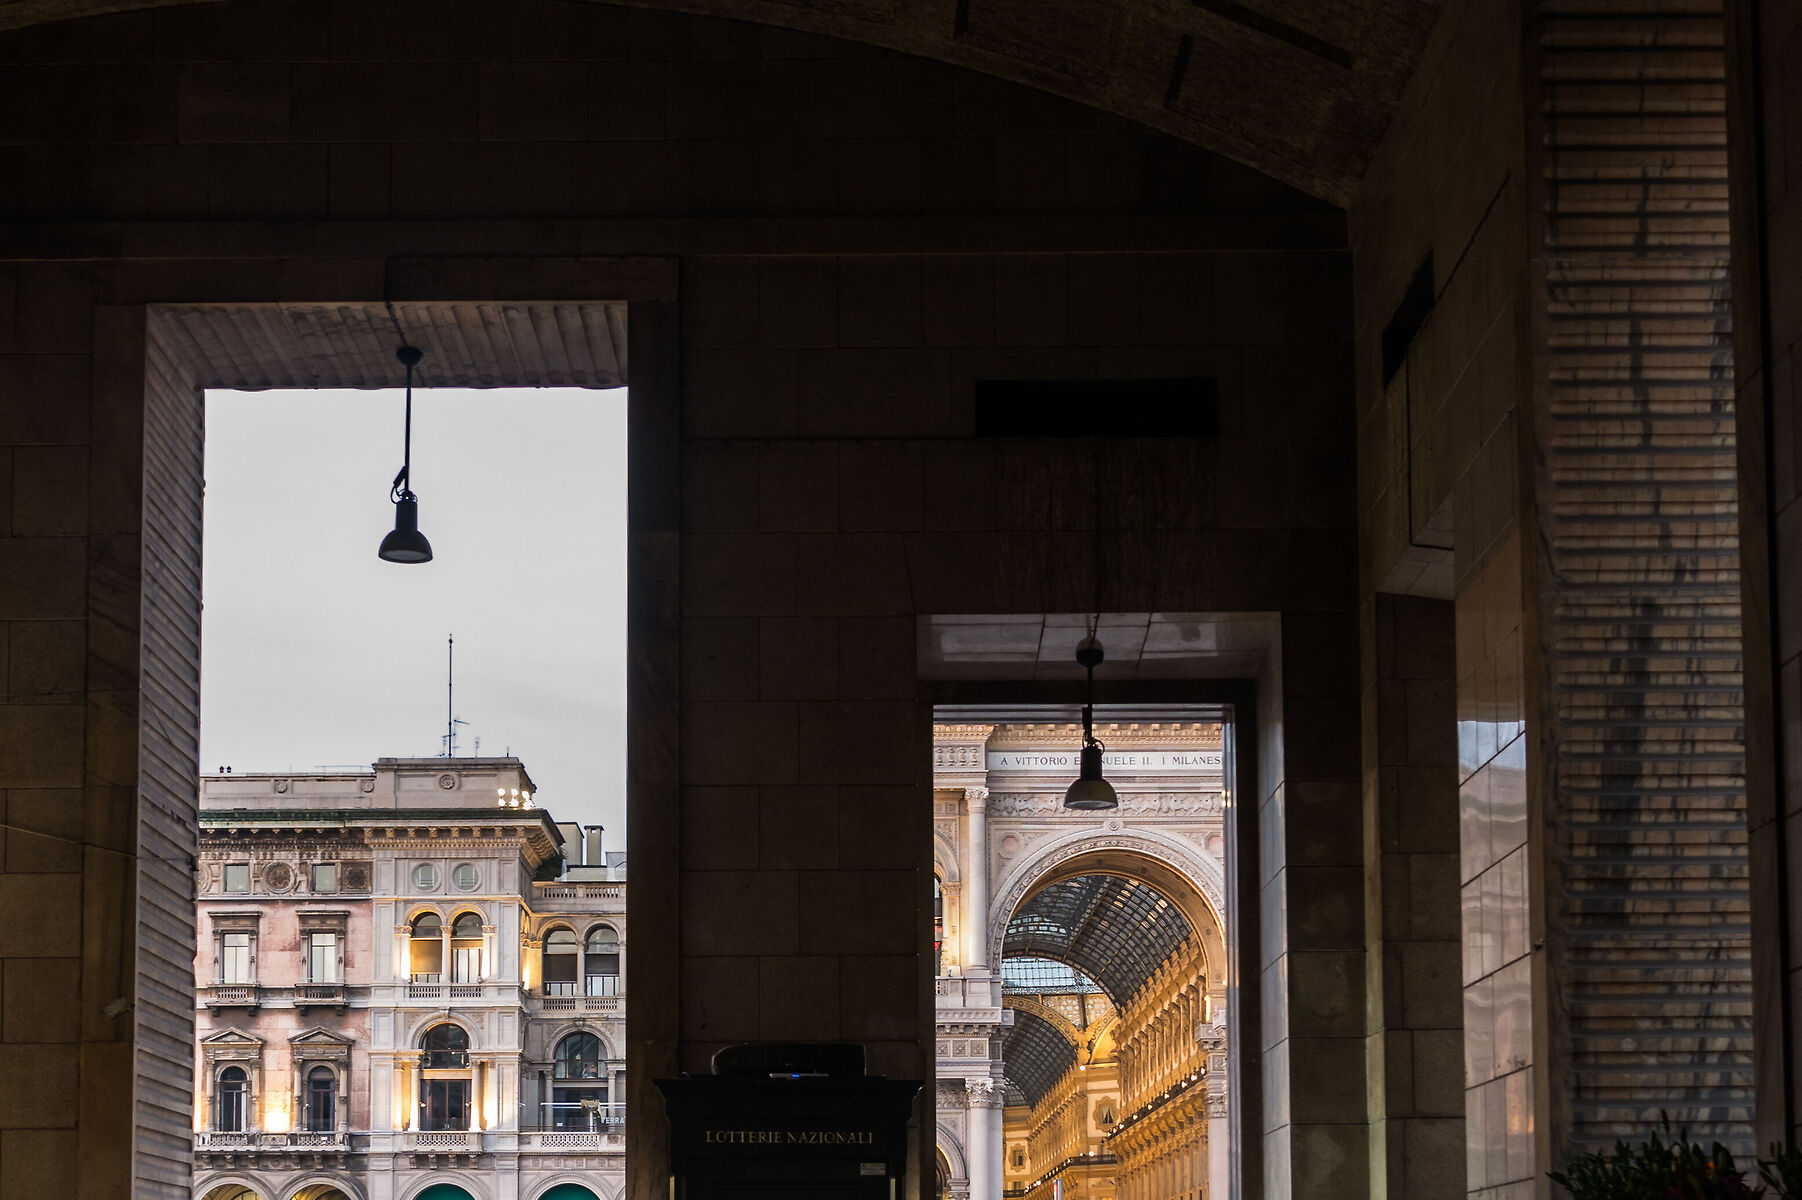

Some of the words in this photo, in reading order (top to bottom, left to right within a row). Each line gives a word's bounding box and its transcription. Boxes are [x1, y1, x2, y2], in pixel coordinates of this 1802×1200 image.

[1000, 757, 1008, 765] A
[1015, 757, 1067, 765] VITTORIO
[1074, 757, 1136, 765] ENUELE
[705, 1130, 783, 1144] LOTTERIE
[787, 1131, 873, 1144] NAZIONALI
